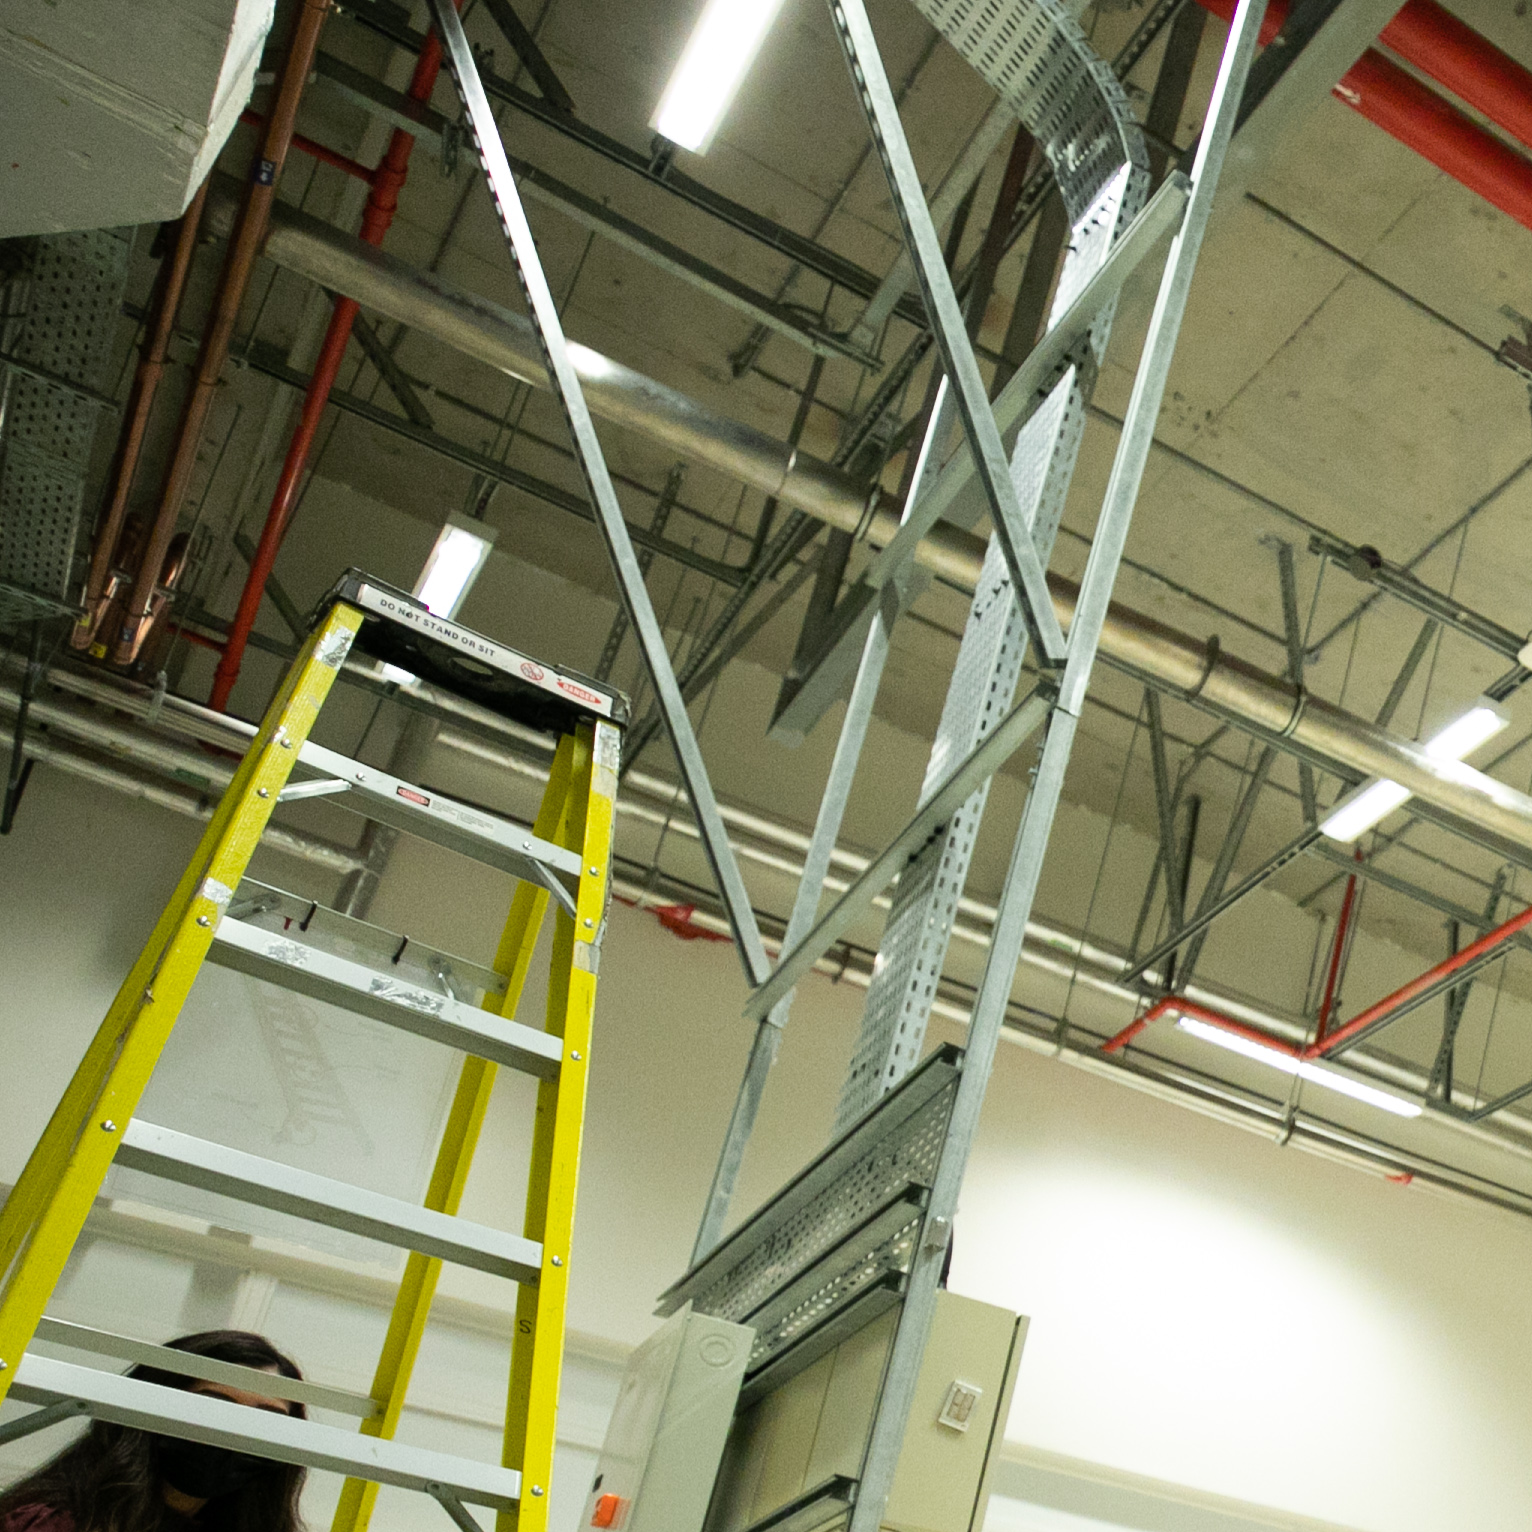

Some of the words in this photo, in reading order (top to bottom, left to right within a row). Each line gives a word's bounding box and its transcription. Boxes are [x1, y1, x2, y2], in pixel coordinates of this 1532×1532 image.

[380, 599, 395, 611] DO
[398, 607, 421, 622] NOT
[423, 619, 459, 640] STAND
[461, 637, 476, 648] OR
[478, 644, 496, 657] SIT
[562, 683, 597, 703] DANGER
